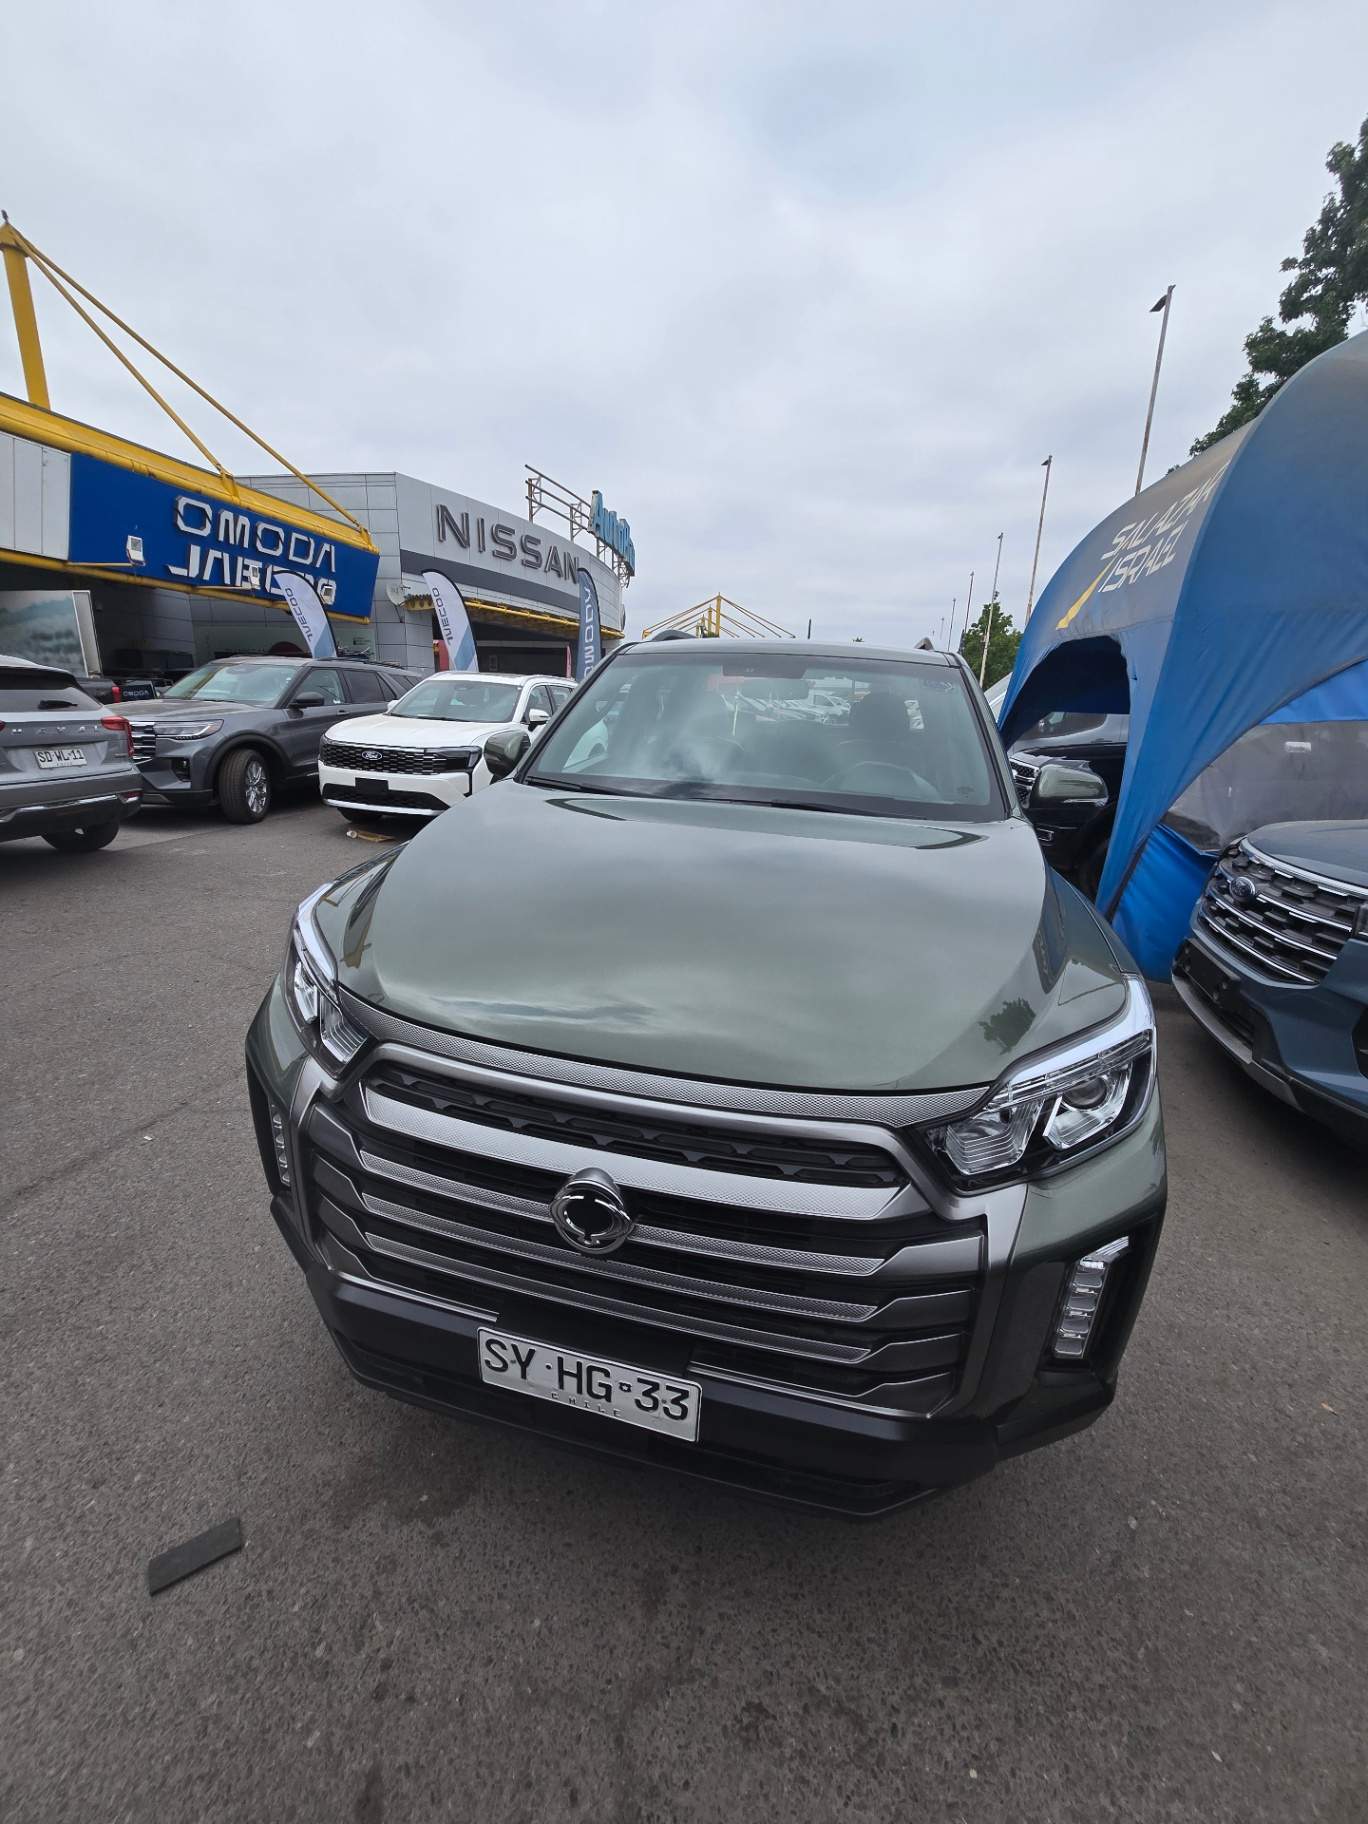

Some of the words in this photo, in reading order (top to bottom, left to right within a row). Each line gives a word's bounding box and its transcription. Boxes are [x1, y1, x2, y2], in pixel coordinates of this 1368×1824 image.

[176, 495, 336, 573] OMODA
[437, 504, 580, 584] NISSAN
[1098, 520, 1189, 593] ISRAEL
[551, 1390, 623, 1418] CHILE
